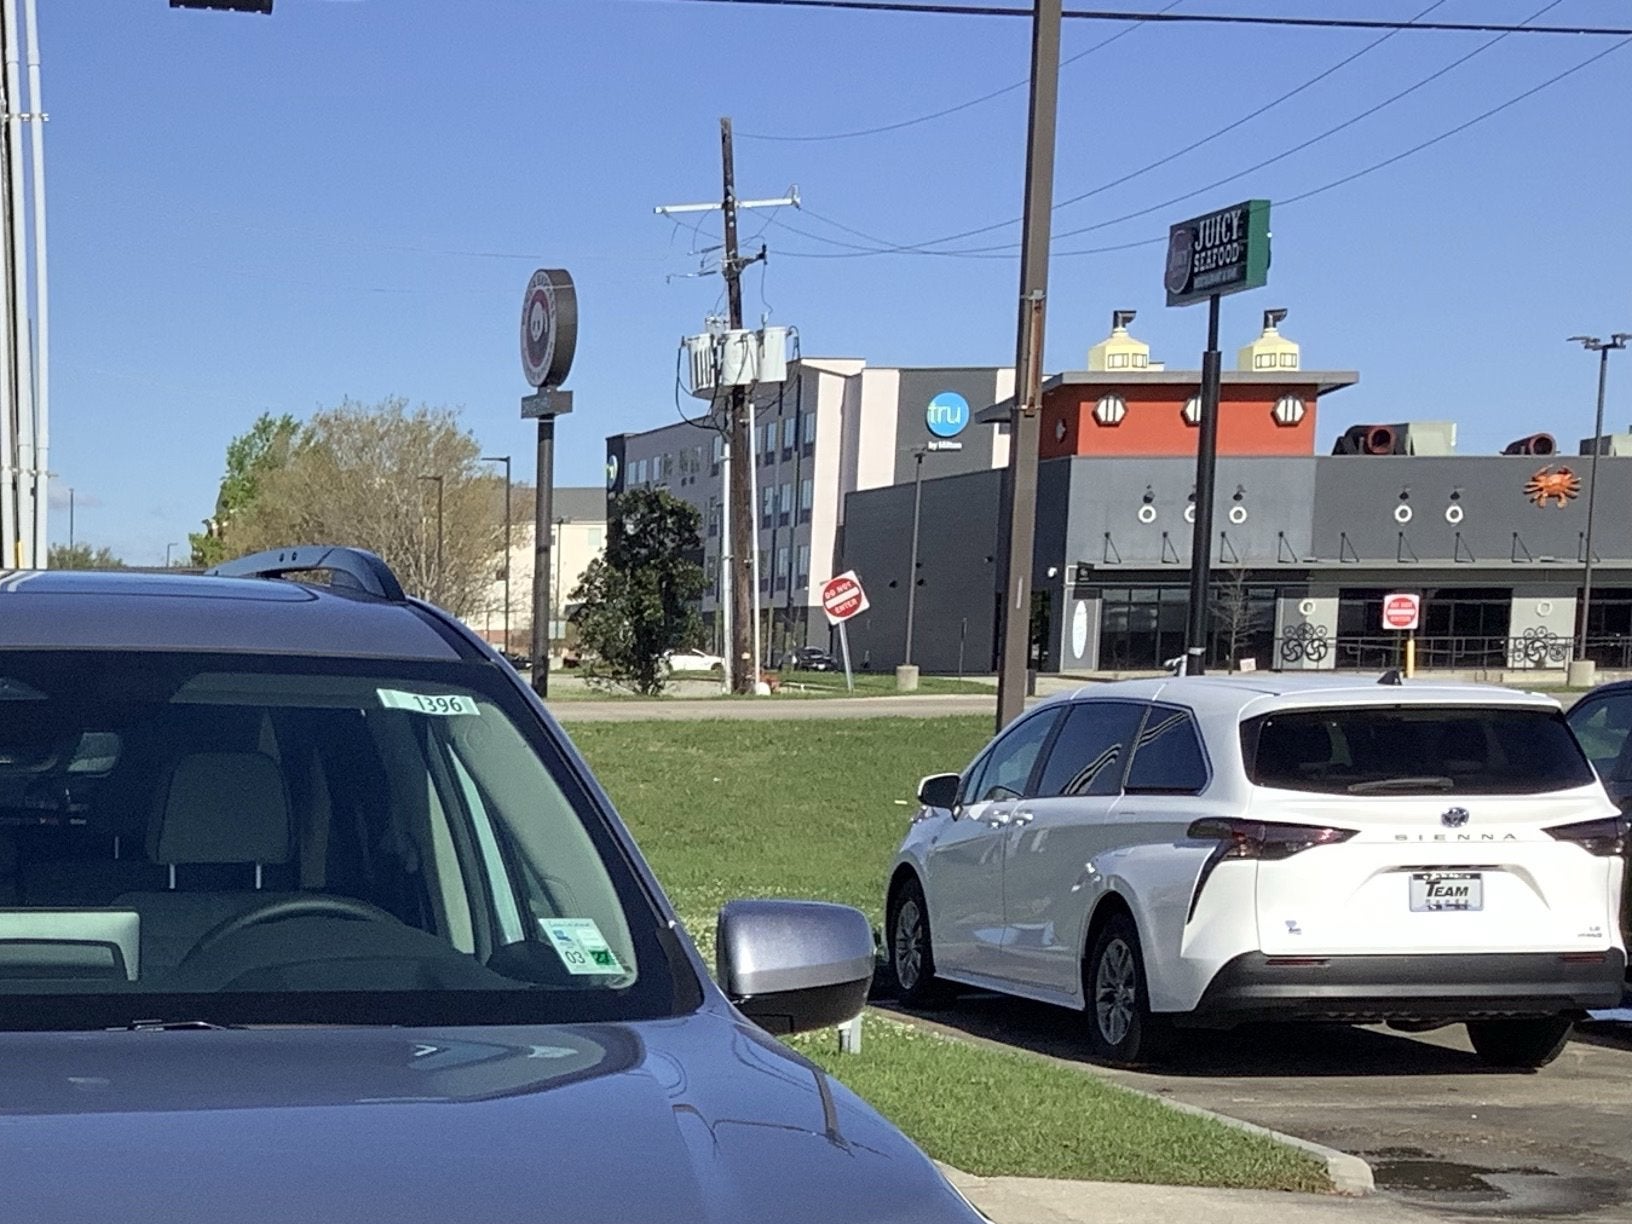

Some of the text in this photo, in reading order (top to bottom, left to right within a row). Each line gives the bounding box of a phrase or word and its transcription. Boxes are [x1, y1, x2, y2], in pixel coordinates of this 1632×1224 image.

[1195, 209, 1241, 251] JUICY
[1194, 242, 1239, 273] SEAFOOD
[928, 400, 961, 425] tru
[412, 695, 463, 713] 1396
[1394, 833, 1517, 841] SIENNA
[1425, 881, 1469, 897] TEAM
[565, 951, 586, 964] 03
